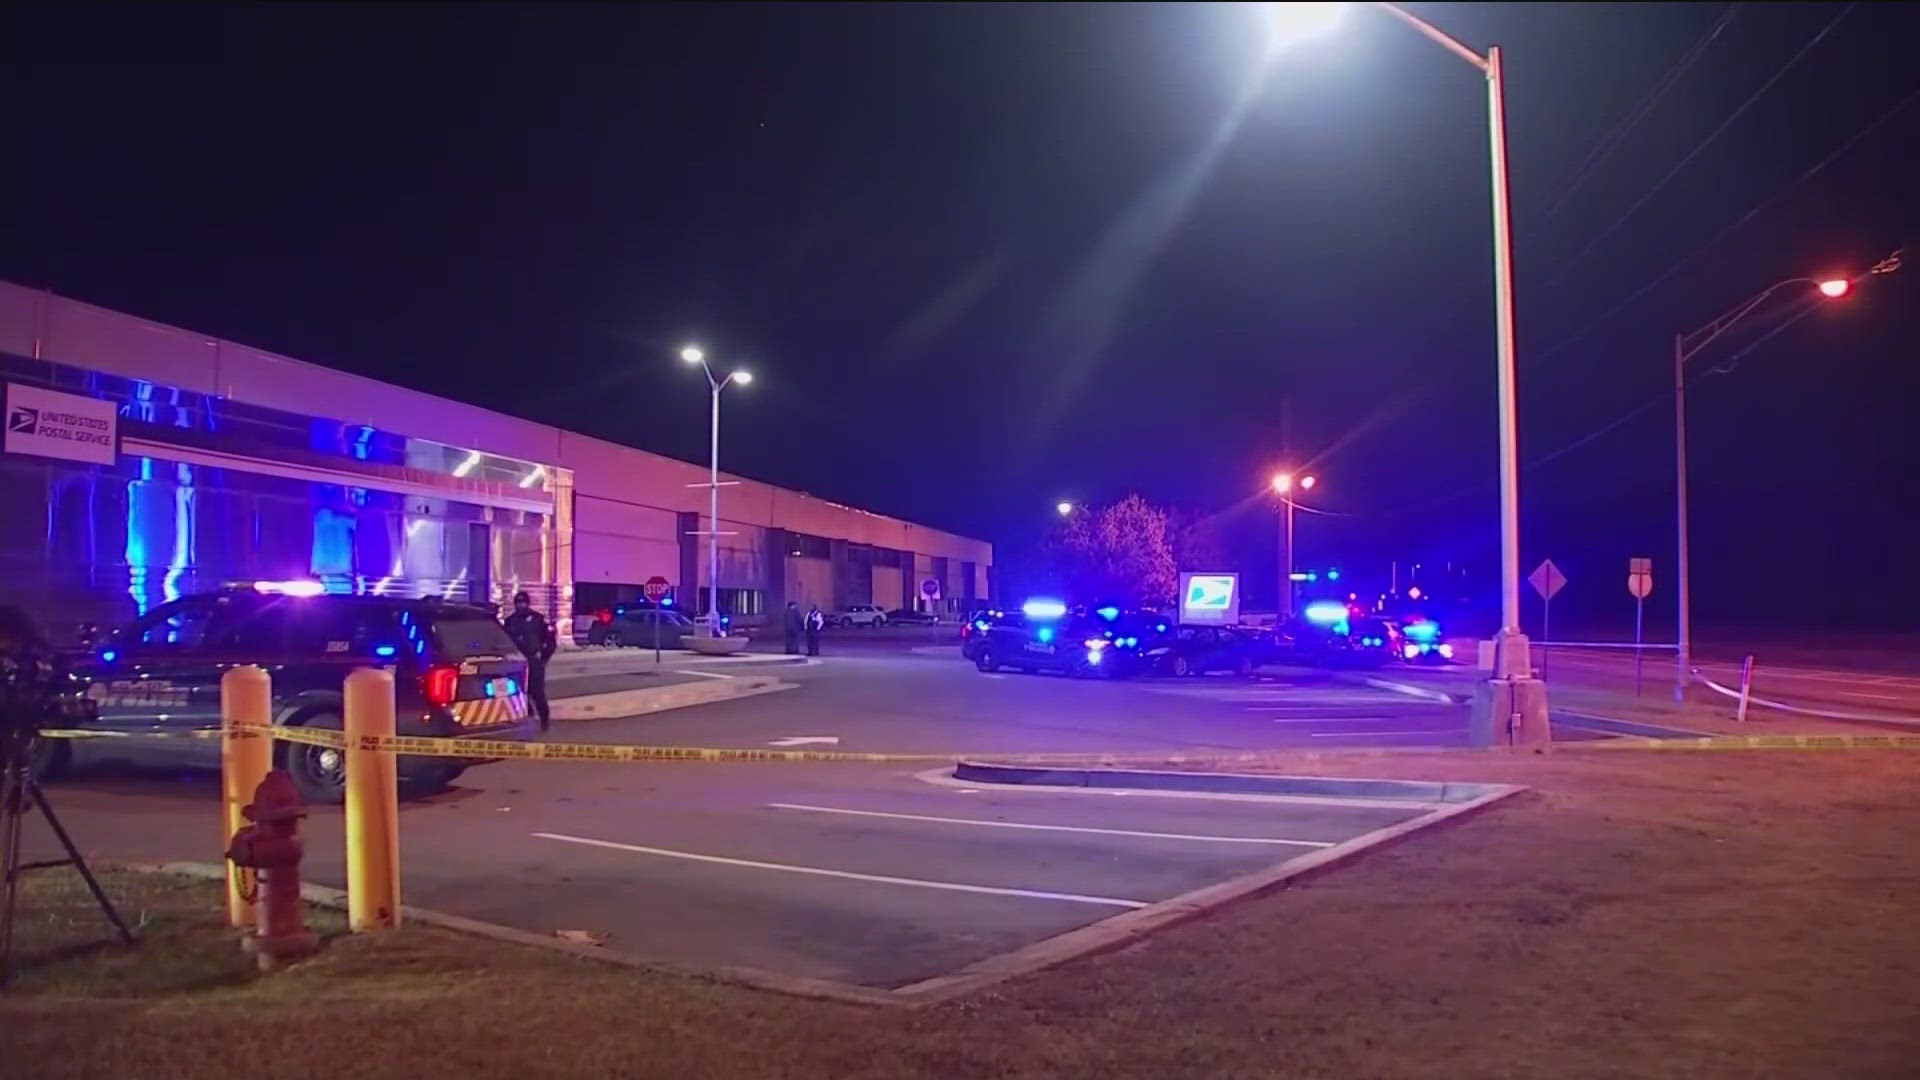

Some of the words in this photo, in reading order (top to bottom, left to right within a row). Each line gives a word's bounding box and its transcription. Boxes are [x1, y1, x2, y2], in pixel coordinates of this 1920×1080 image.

[41, 412, 77, 426] UNITED
[79, 417, 109, 431] STATES
[39, 425, 73, 440] POSTAL
[75, 431, 111, 446] SERVICE
[646, 583, 669, 595] STOP
